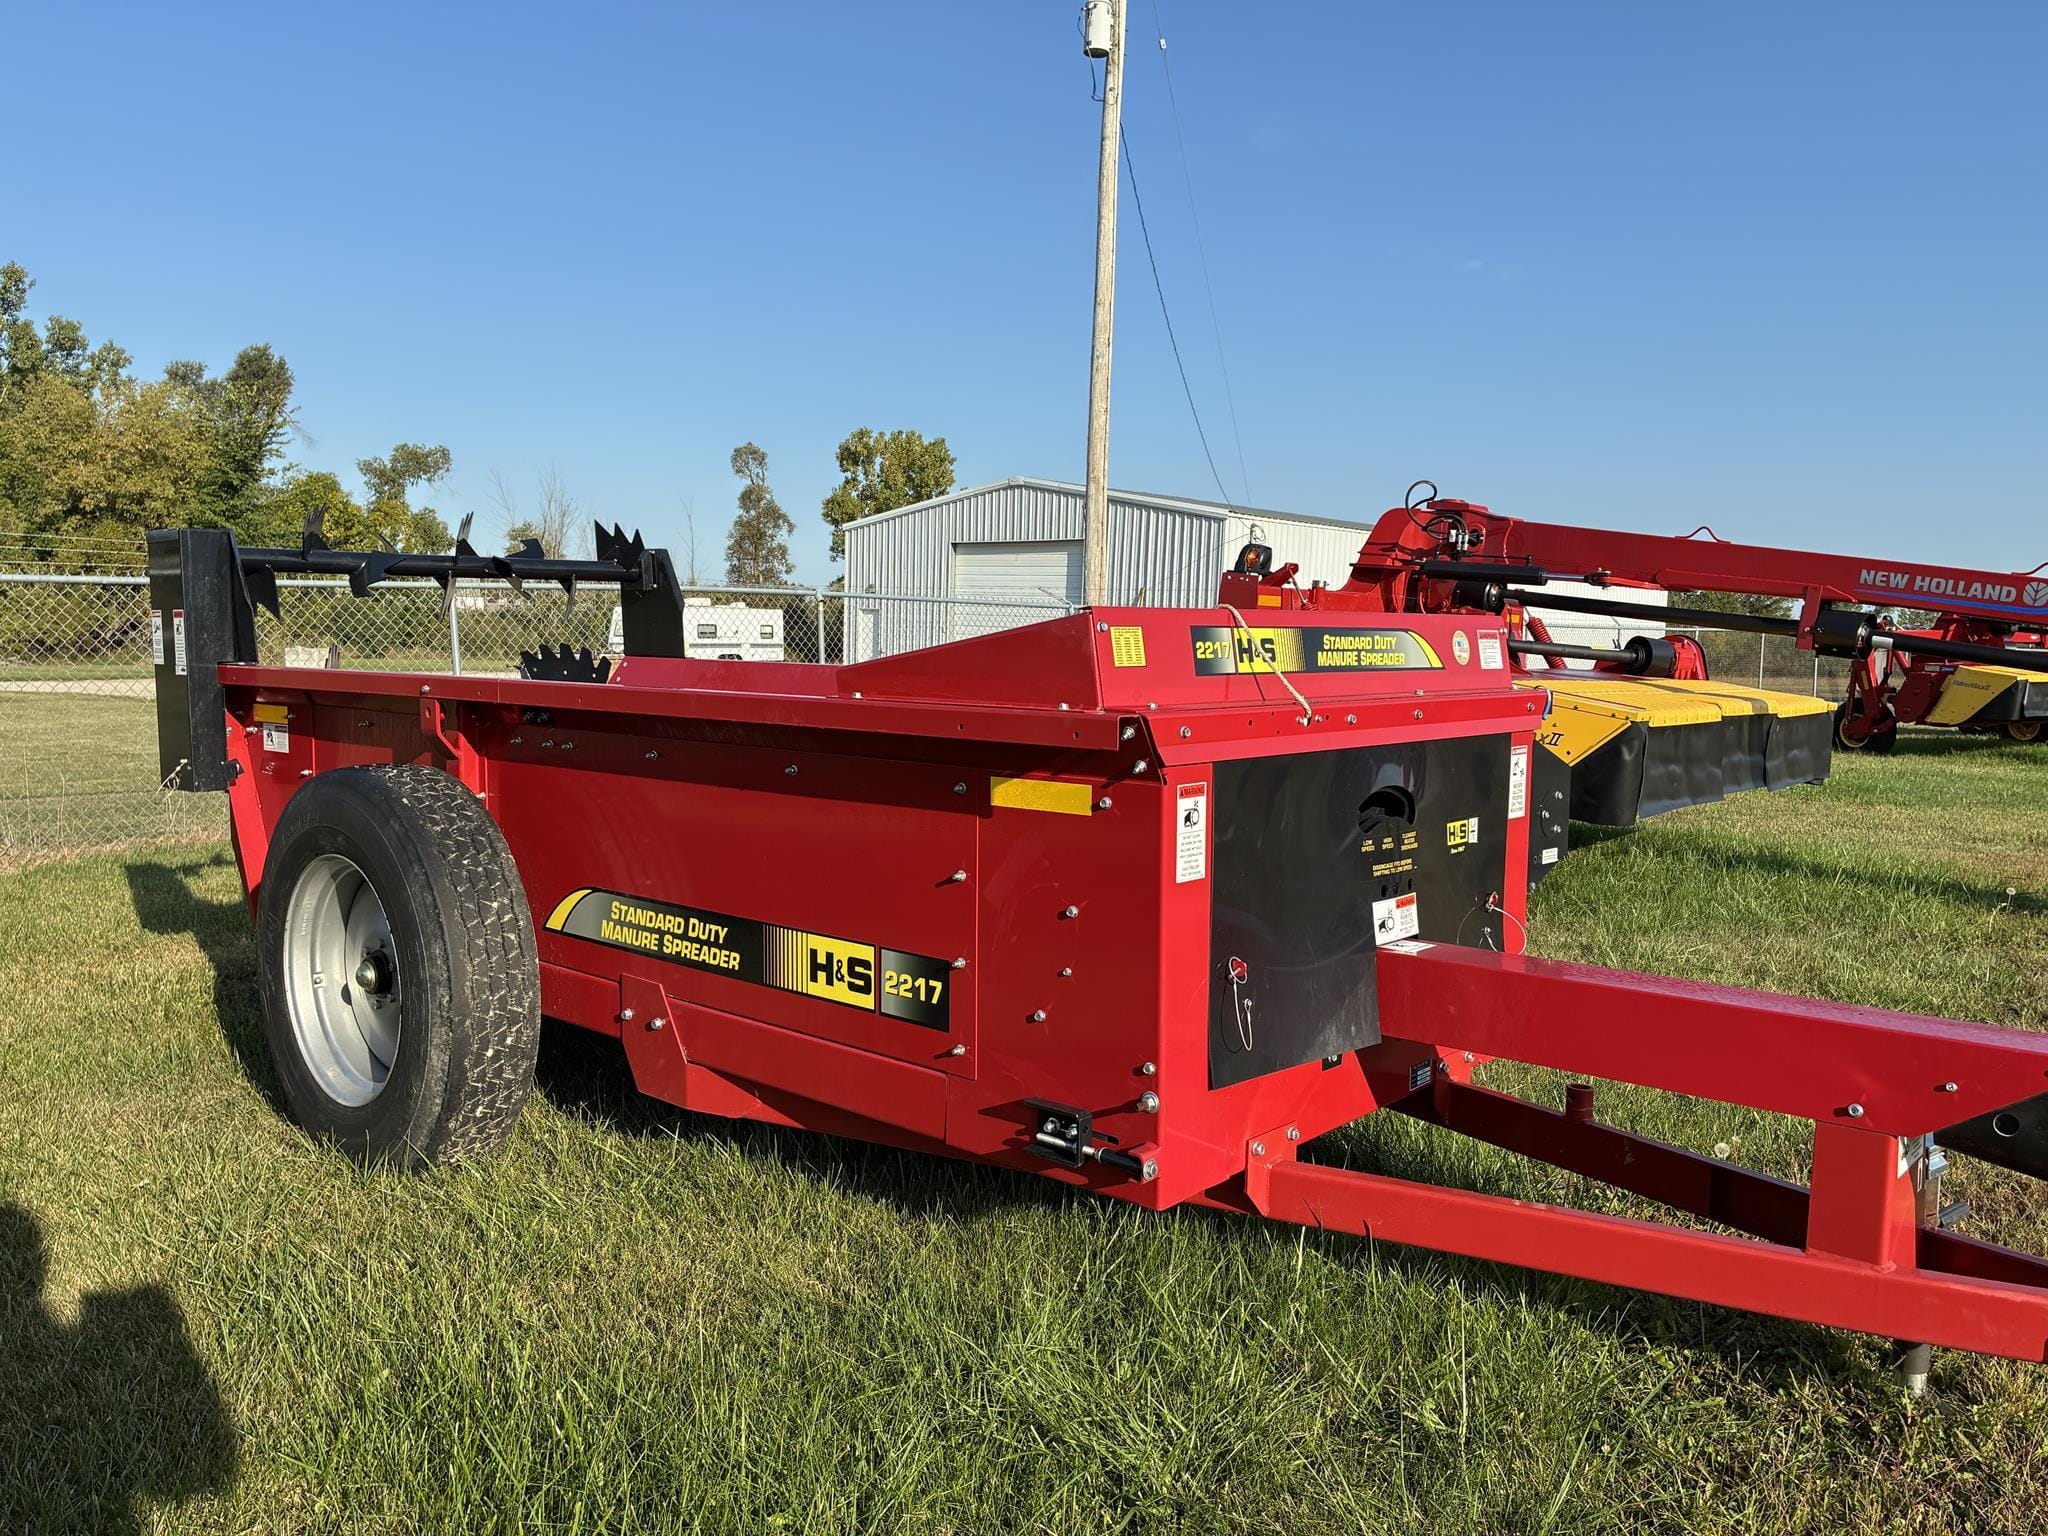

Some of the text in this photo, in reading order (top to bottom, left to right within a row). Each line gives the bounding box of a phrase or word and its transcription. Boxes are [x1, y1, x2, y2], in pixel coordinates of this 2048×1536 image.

[1859, 568, 2017, 603] NEW HOLLAND
[1195, 641, 1231, 660] 2217
[1317, 651, 1406, 667] MANURE SPREADER
[1322, 634, 1397, 650] STANDARD DUTY
[610, 900, 729, 945] STANDARD DUTY
[601, 919, 741, 971] MANURE SPREADER
[808, 947, 873, 996] H&S
[884, 969, 943, 1006] 2217
